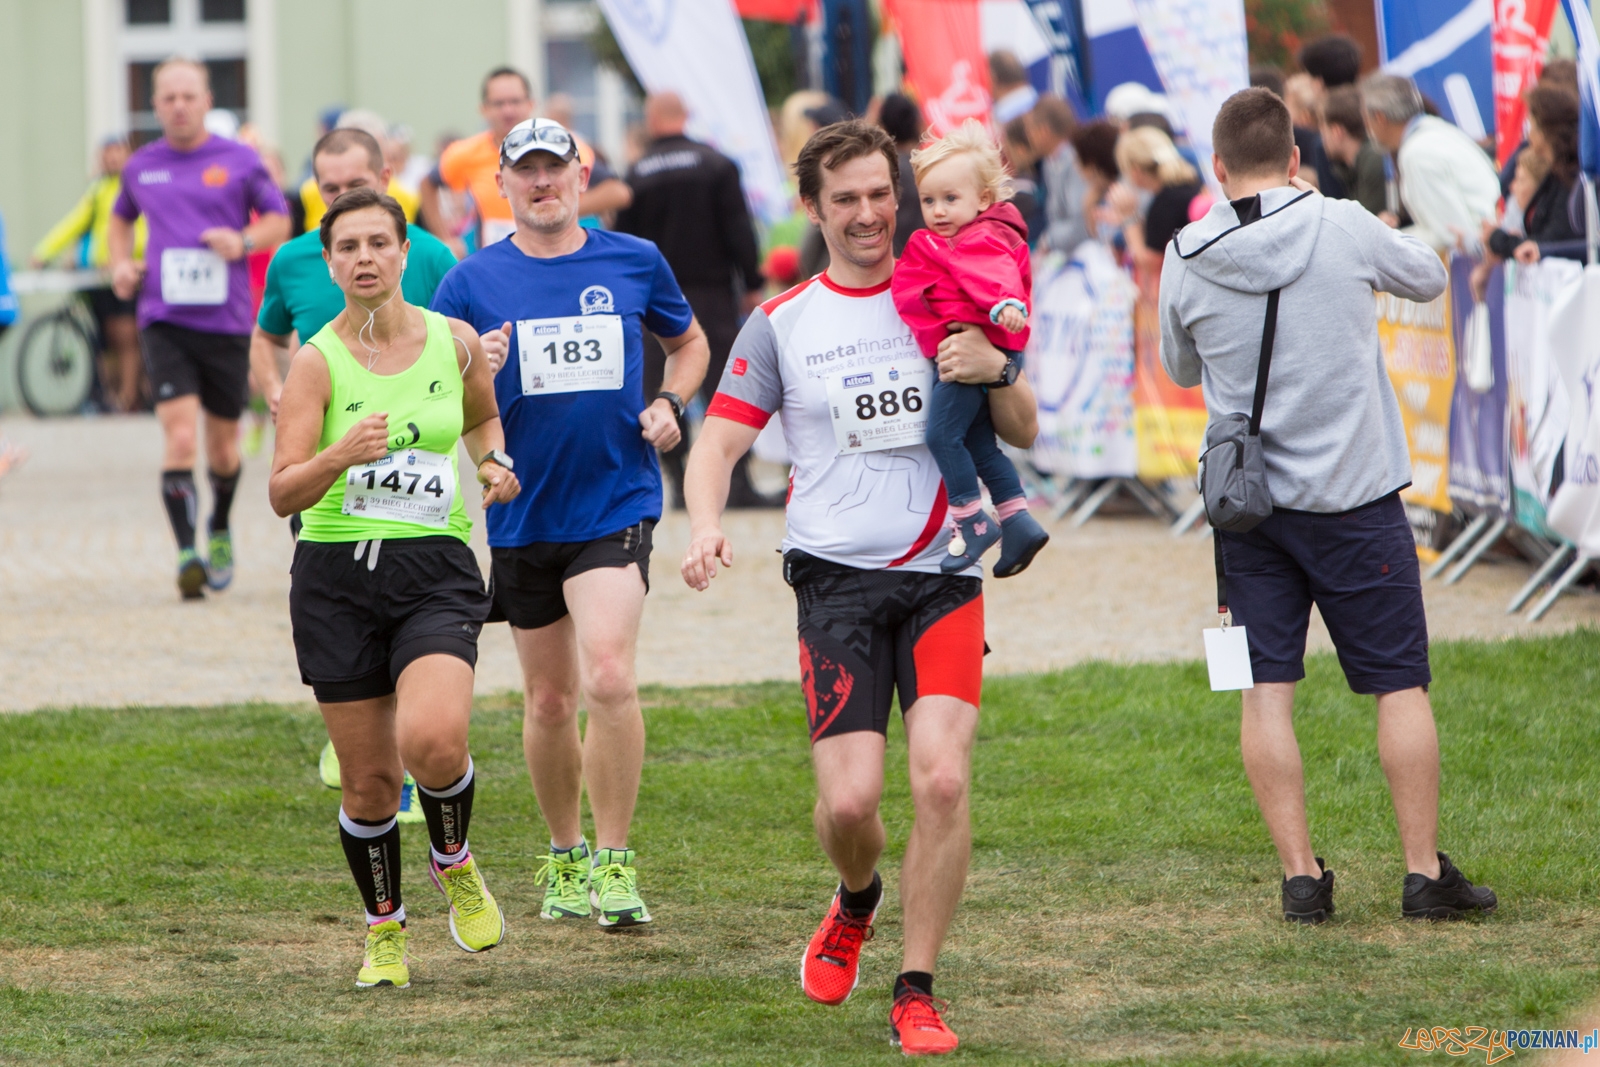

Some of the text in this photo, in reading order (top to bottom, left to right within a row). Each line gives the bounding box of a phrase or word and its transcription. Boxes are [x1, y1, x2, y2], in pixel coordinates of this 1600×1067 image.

[543, 339, 602, 365] 183
[805, 334, 915, 366] metafinanz
[546, 371, 556, 379] 39
[557, 370, 575, 378] BIEG
[807, 349, 918, 379] Business & IT Consulting
[345, 401, 364, 412] 4F
[855, 386, 923, 420] 886
[862, 428, 873, 437] 39
[875, 425, 896, 435] BIEG
[361, 469, 444, 498] 1474
[370, 496, 380, 505] 39
[382, 498, 401, 507] BIEG
[403, 501, 443, 513] LECHITÓW
